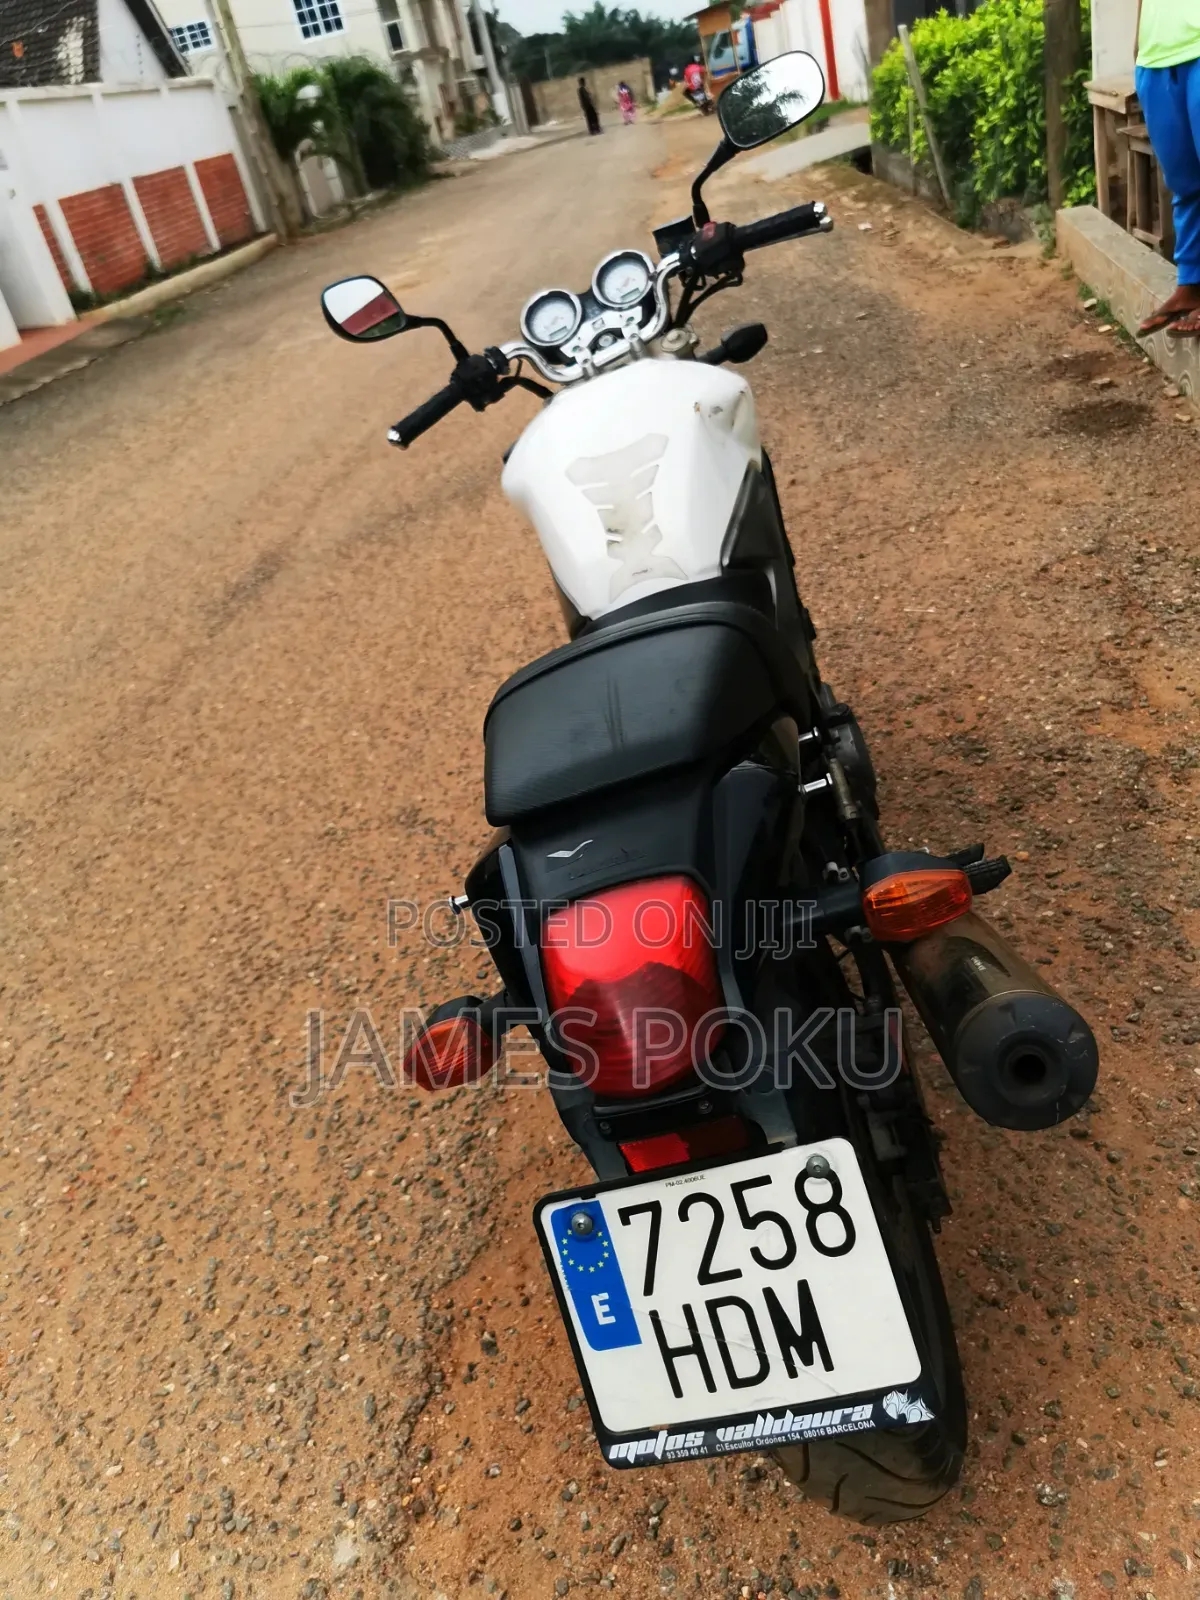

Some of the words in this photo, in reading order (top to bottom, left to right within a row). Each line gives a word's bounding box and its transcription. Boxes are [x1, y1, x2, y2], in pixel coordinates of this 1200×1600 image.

[617, 1168, 856, 1296] 7258
[591, 1292, 616, 1325] E
[649, 1279, 835, 1398] HDM
[608, 1430, 705, 1464] motos
[716, 1404, 874, 1442] valldaura
[804, 1429, 826, 1439] 08016
[827, 1419, 876, 1435] BARCELONA
[666, 1451, 675, 1459] 93
[677, 1449, 689, 1458] 359
[690, 1448, 699, 1456] 40
[700, 1446, 709, 1454] 41
